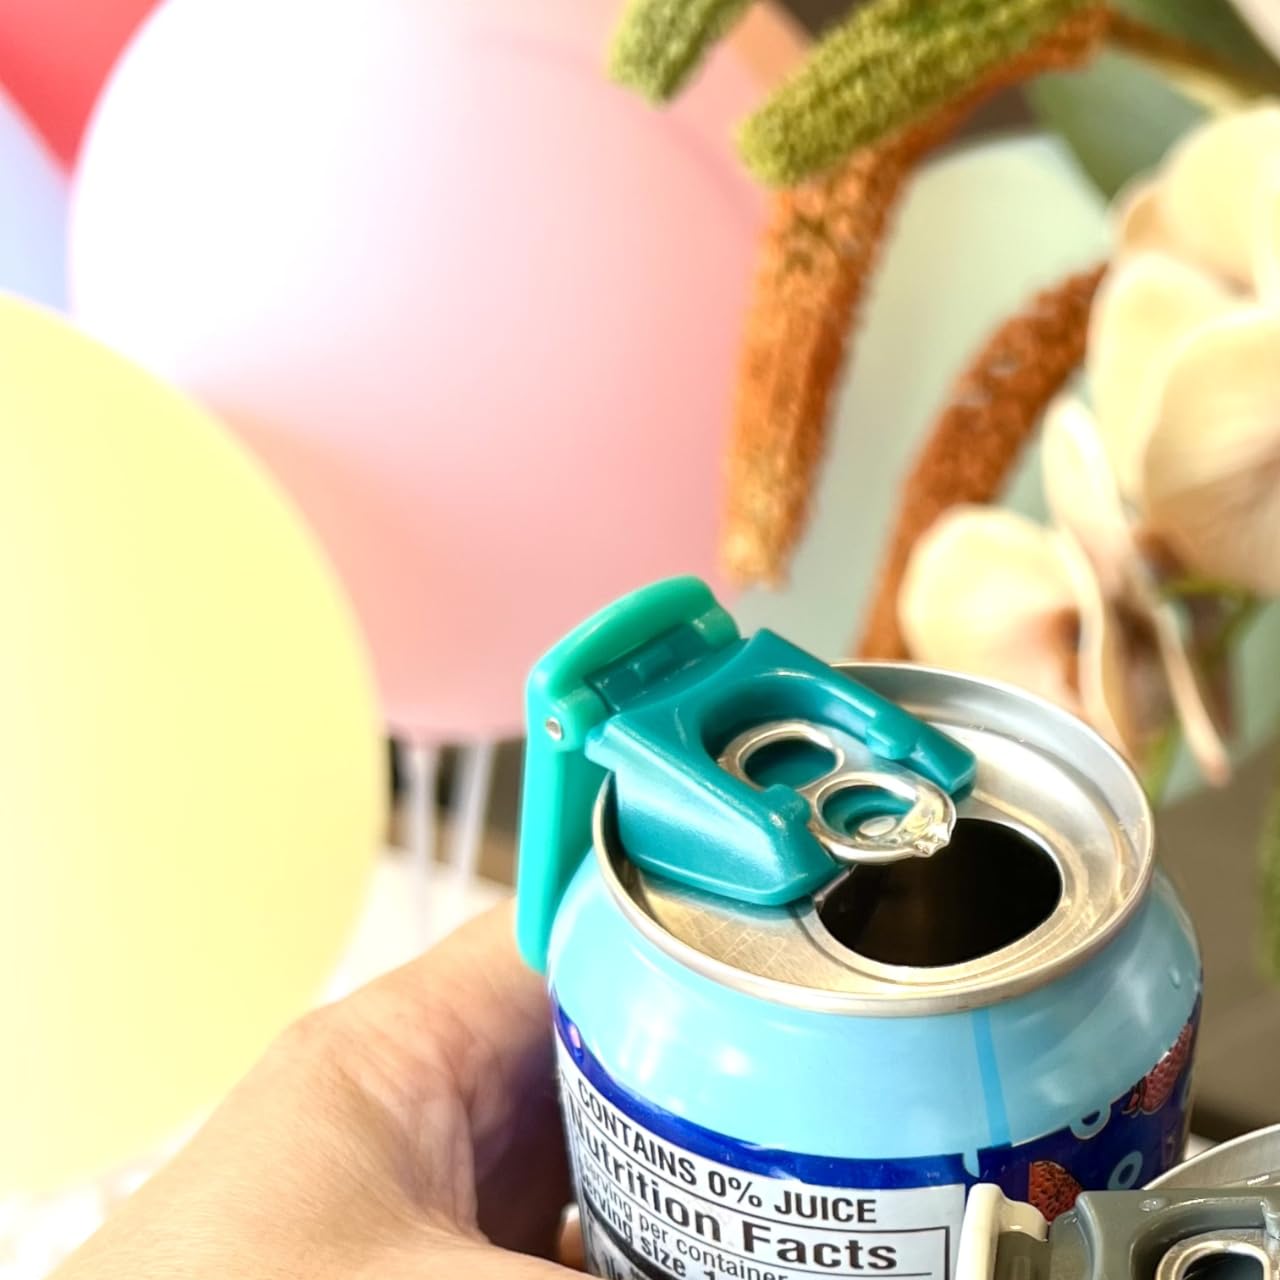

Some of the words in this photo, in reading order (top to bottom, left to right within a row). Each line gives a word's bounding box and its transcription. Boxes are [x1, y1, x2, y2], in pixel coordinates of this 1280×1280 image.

[570, 1094, 721, 1243] Nutrition
[742, 1220, 897, 1270] Facts
[578, 1078, 697, 1186] CONTAINS
[708, 1170, 762, 1208] 0%
[774, 1190, 877, 1223] JUICE
[639, 1214, 669, 1244] per
[641, 1235, 687, 1277] size
